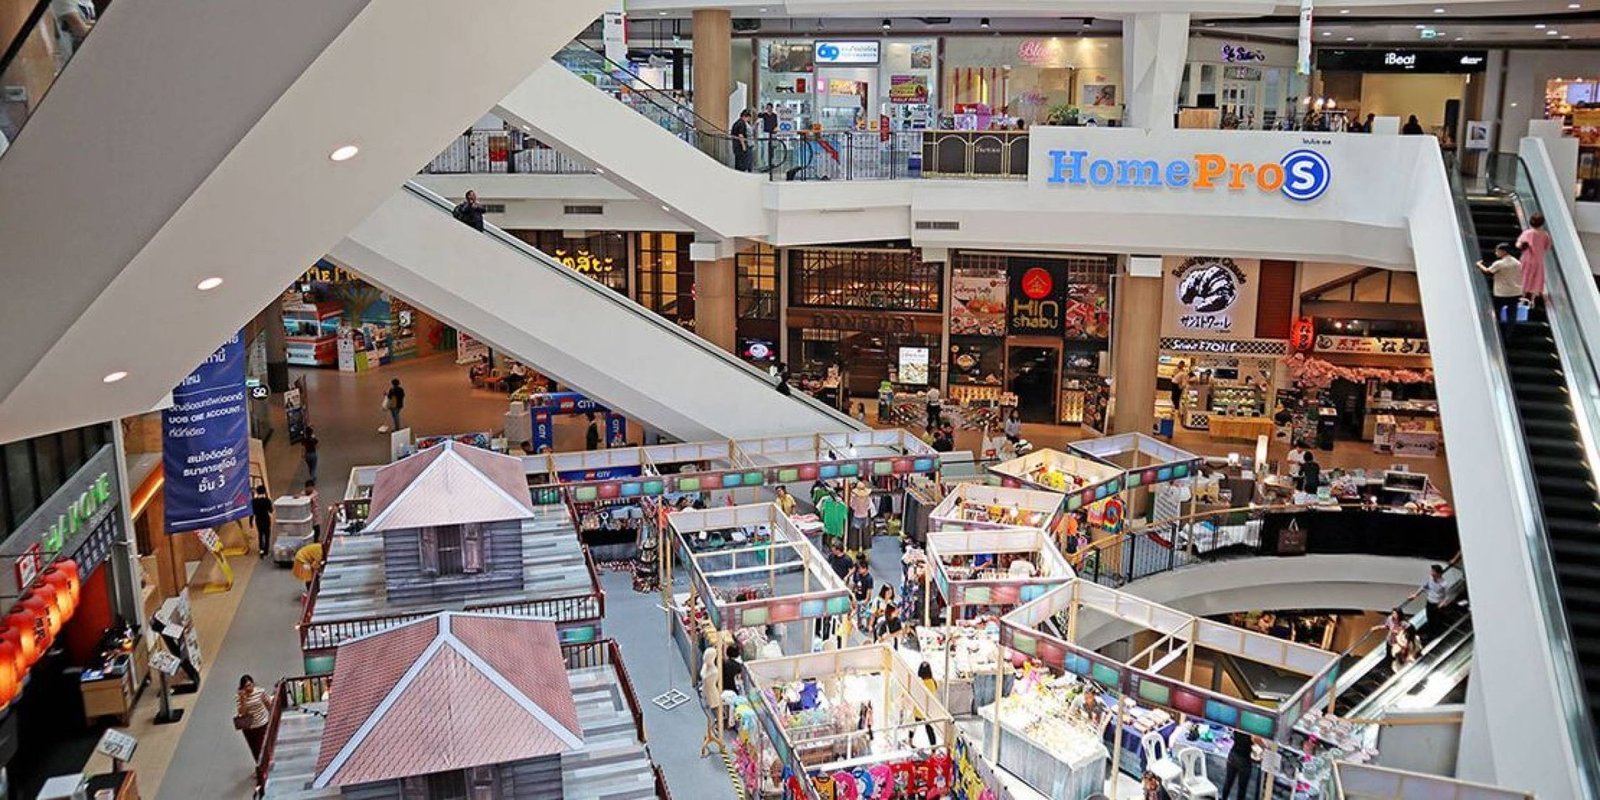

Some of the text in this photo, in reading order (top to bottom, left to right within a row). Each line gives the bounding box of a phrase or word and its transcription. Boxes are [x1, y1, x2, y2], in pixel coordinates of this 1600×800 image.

[1384, 52, 1416, 65] iBeat
[577, 399, 596, 409] CITY
[168, 405, 240, 424] UOB ONE ACCOUNT
[198, 474, 226, 493] ชั้น 3
